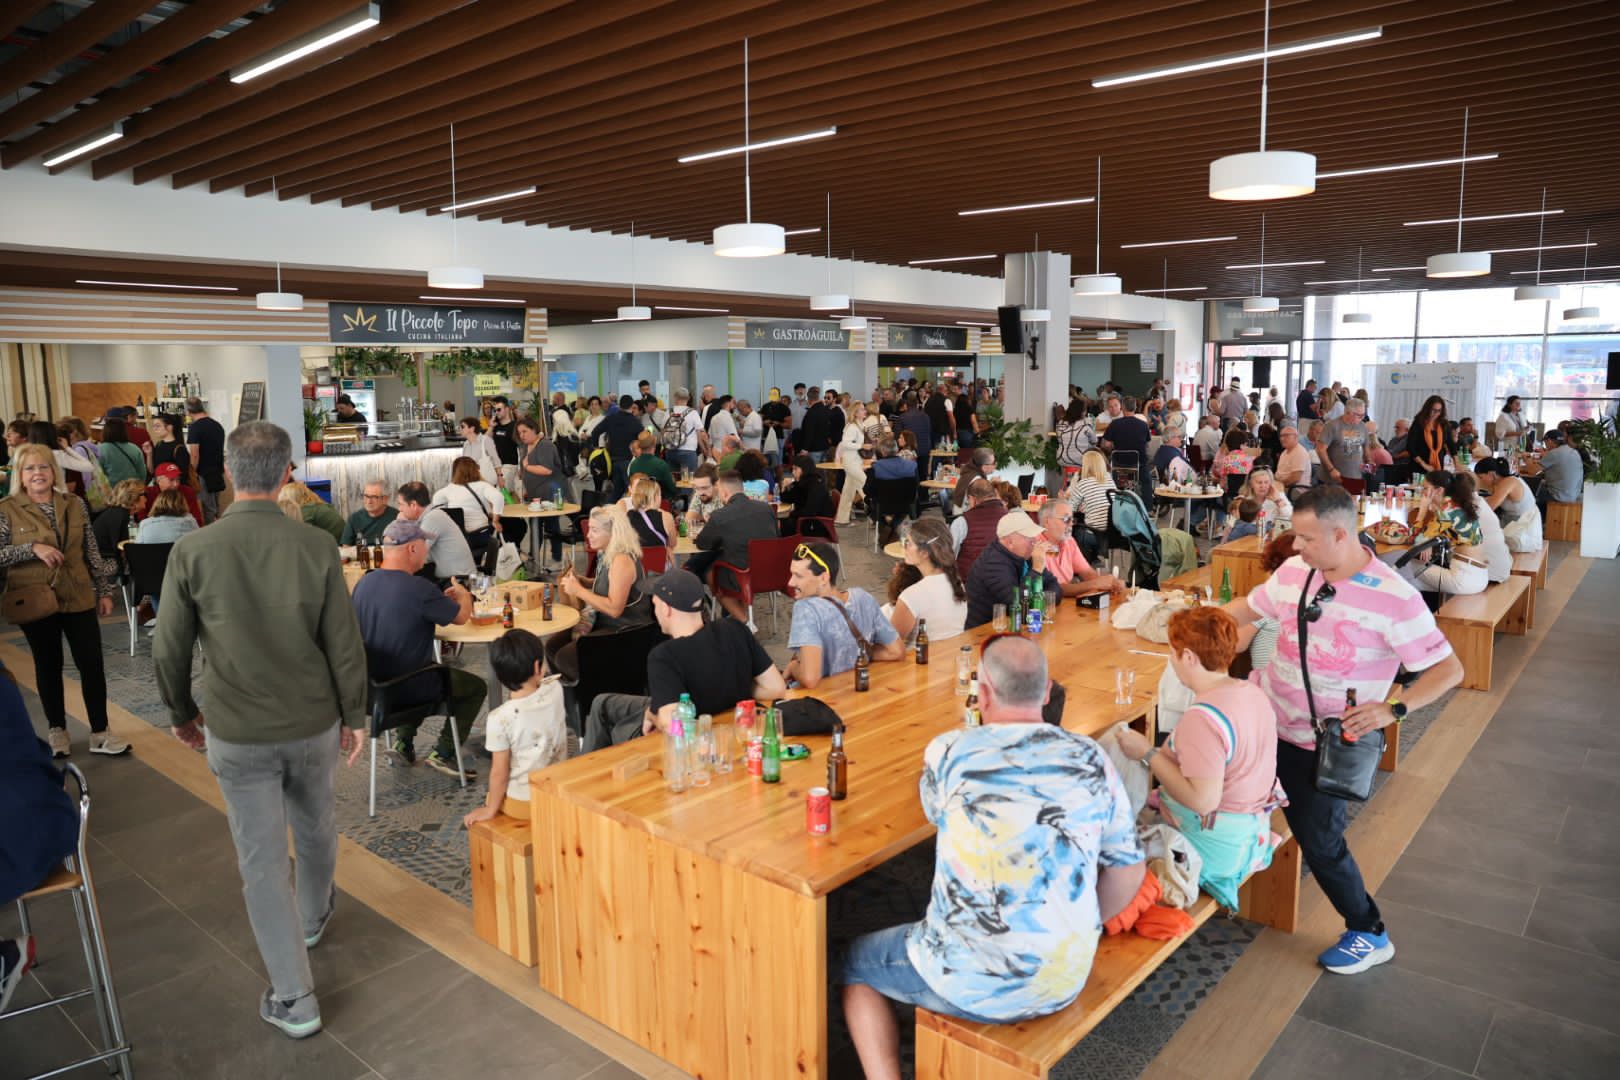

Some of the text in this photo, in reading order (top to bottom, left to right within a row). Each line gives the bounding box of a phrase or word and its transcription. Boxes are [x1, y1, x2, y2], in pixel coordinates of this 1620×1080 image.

[385, 308, 398, 332] Il
[401, 308, 444, 333] Piccolo
[447, 309, 479, 337] Topo
[772, 327, 844, 342] GASTROÁGUILA
